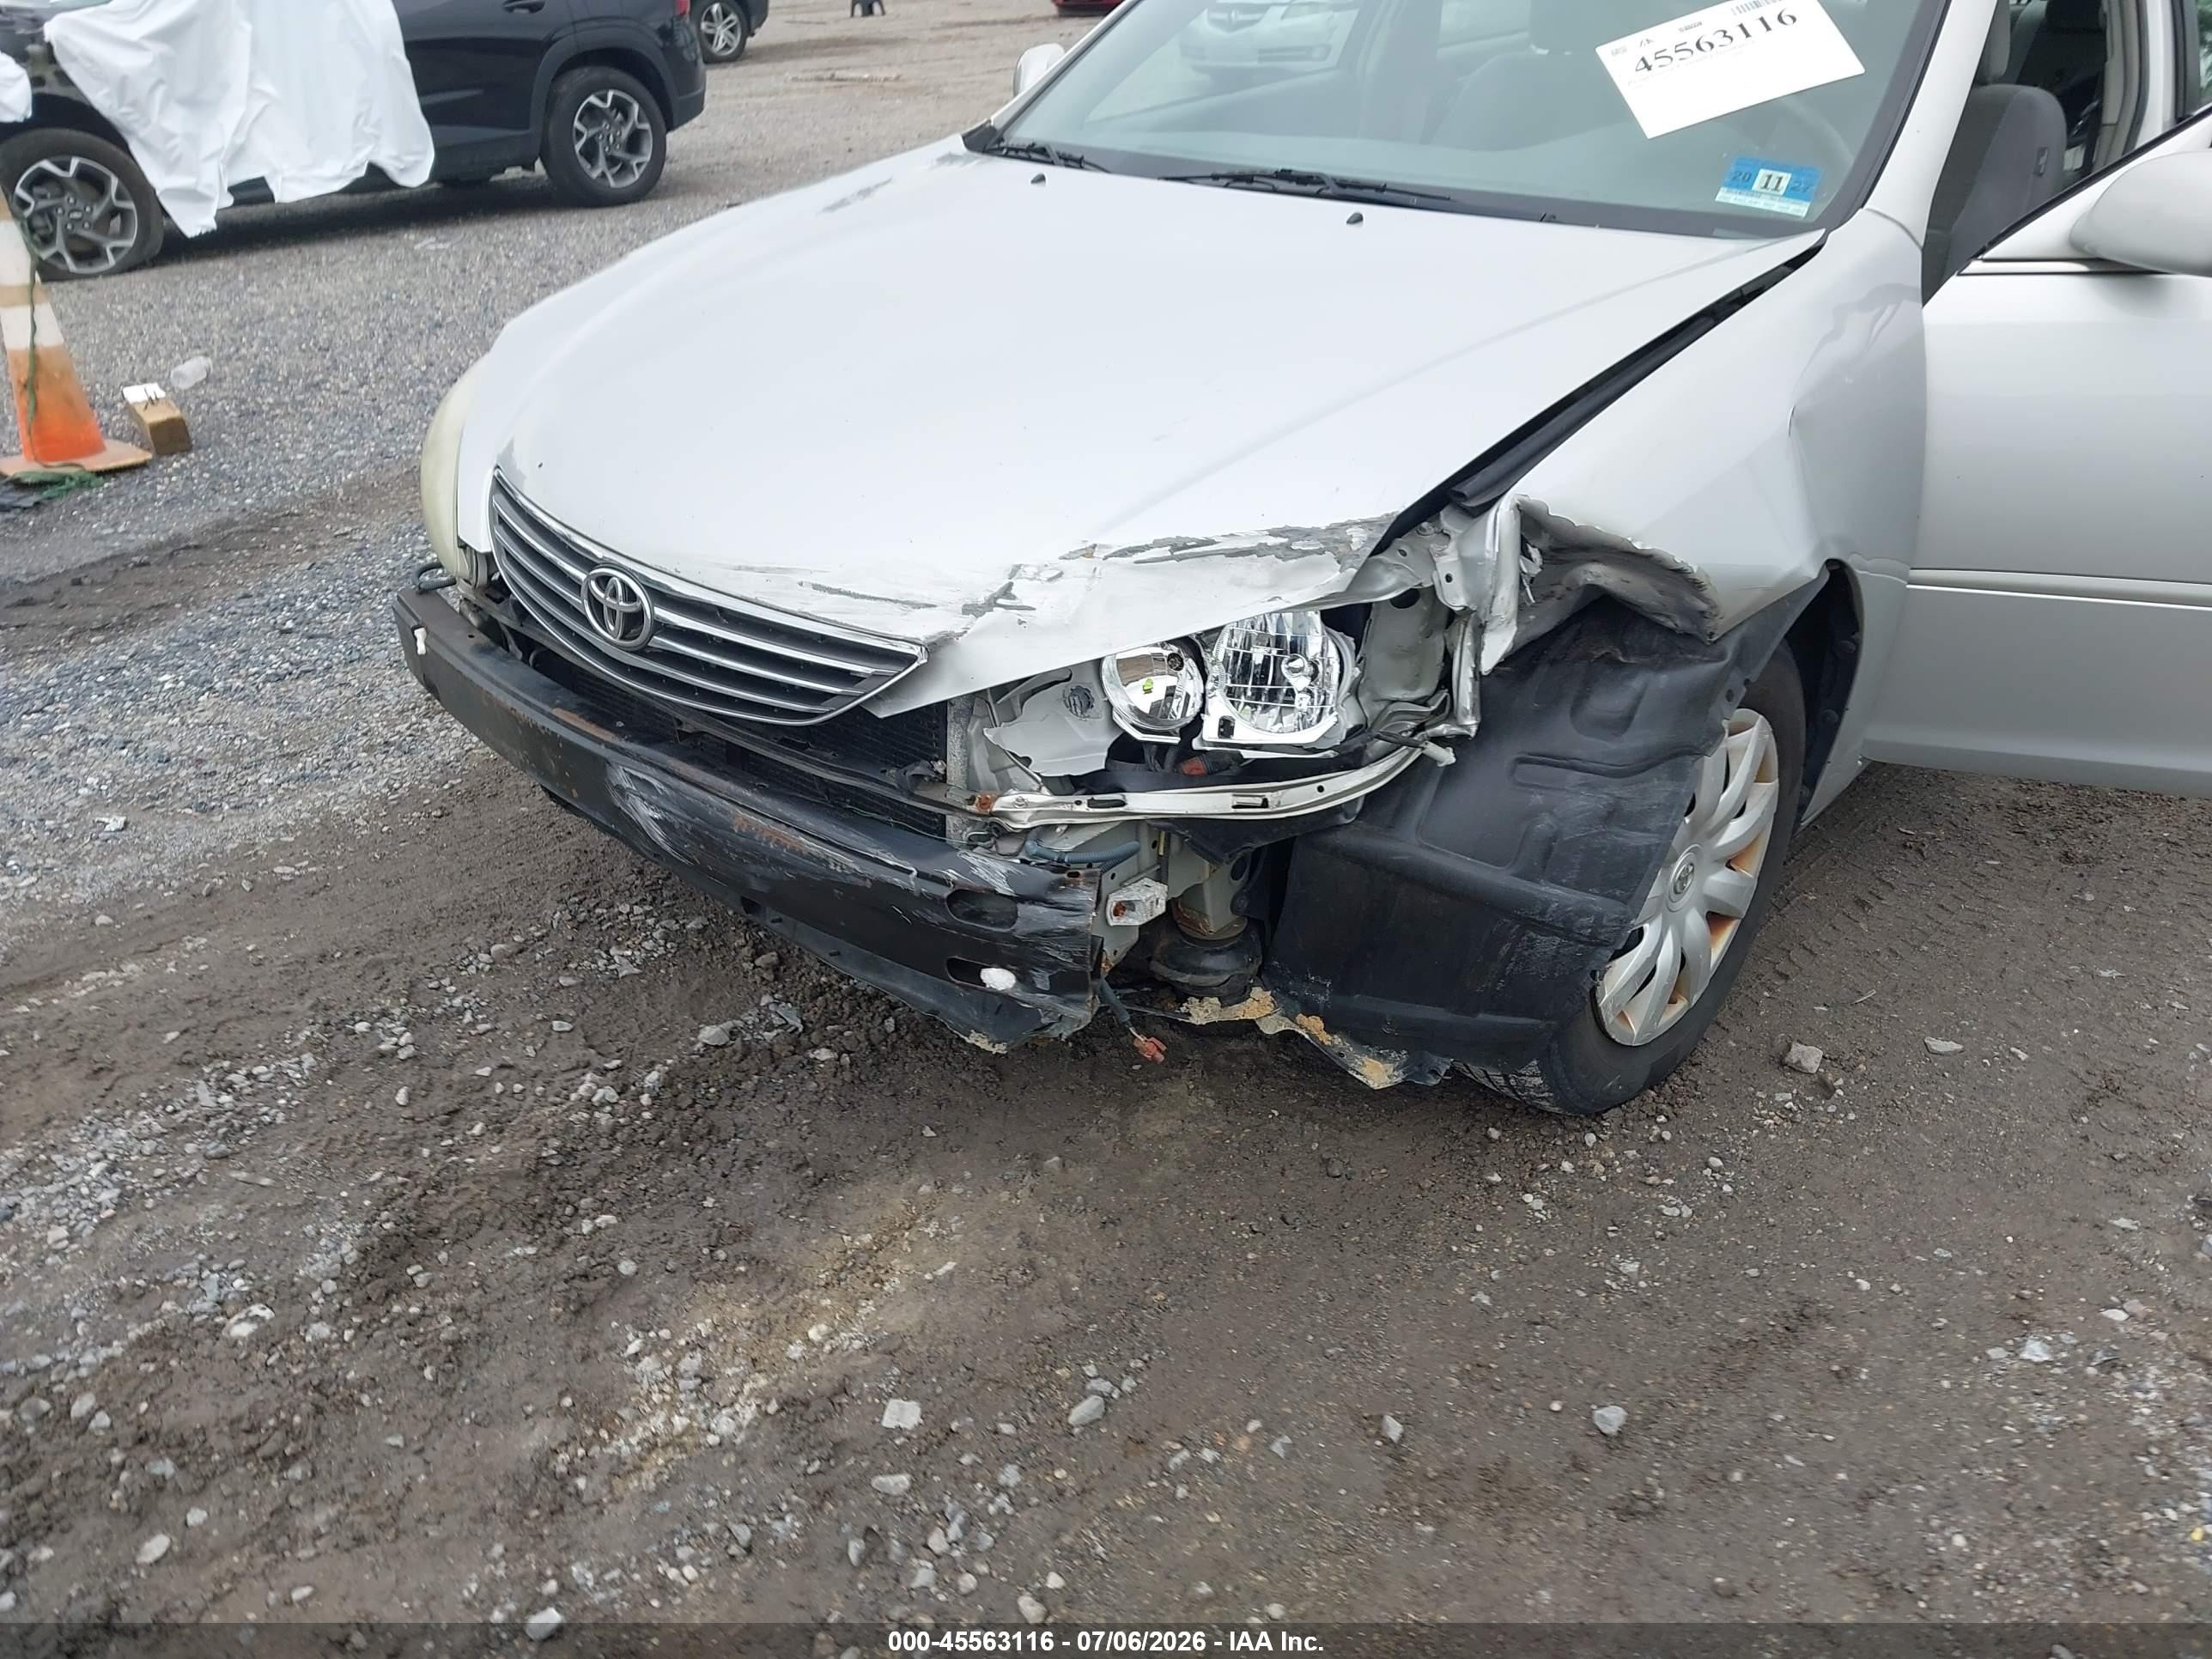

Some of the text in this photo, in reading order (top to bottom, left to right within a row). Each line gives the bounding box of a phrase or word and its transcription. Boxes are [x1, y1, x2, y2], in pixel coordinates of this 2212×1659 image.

[1635, 8, 1796, 72] 45563116
[1732, 172, 1752, 183] 20
[1760, 174, 1784, 192] 11
